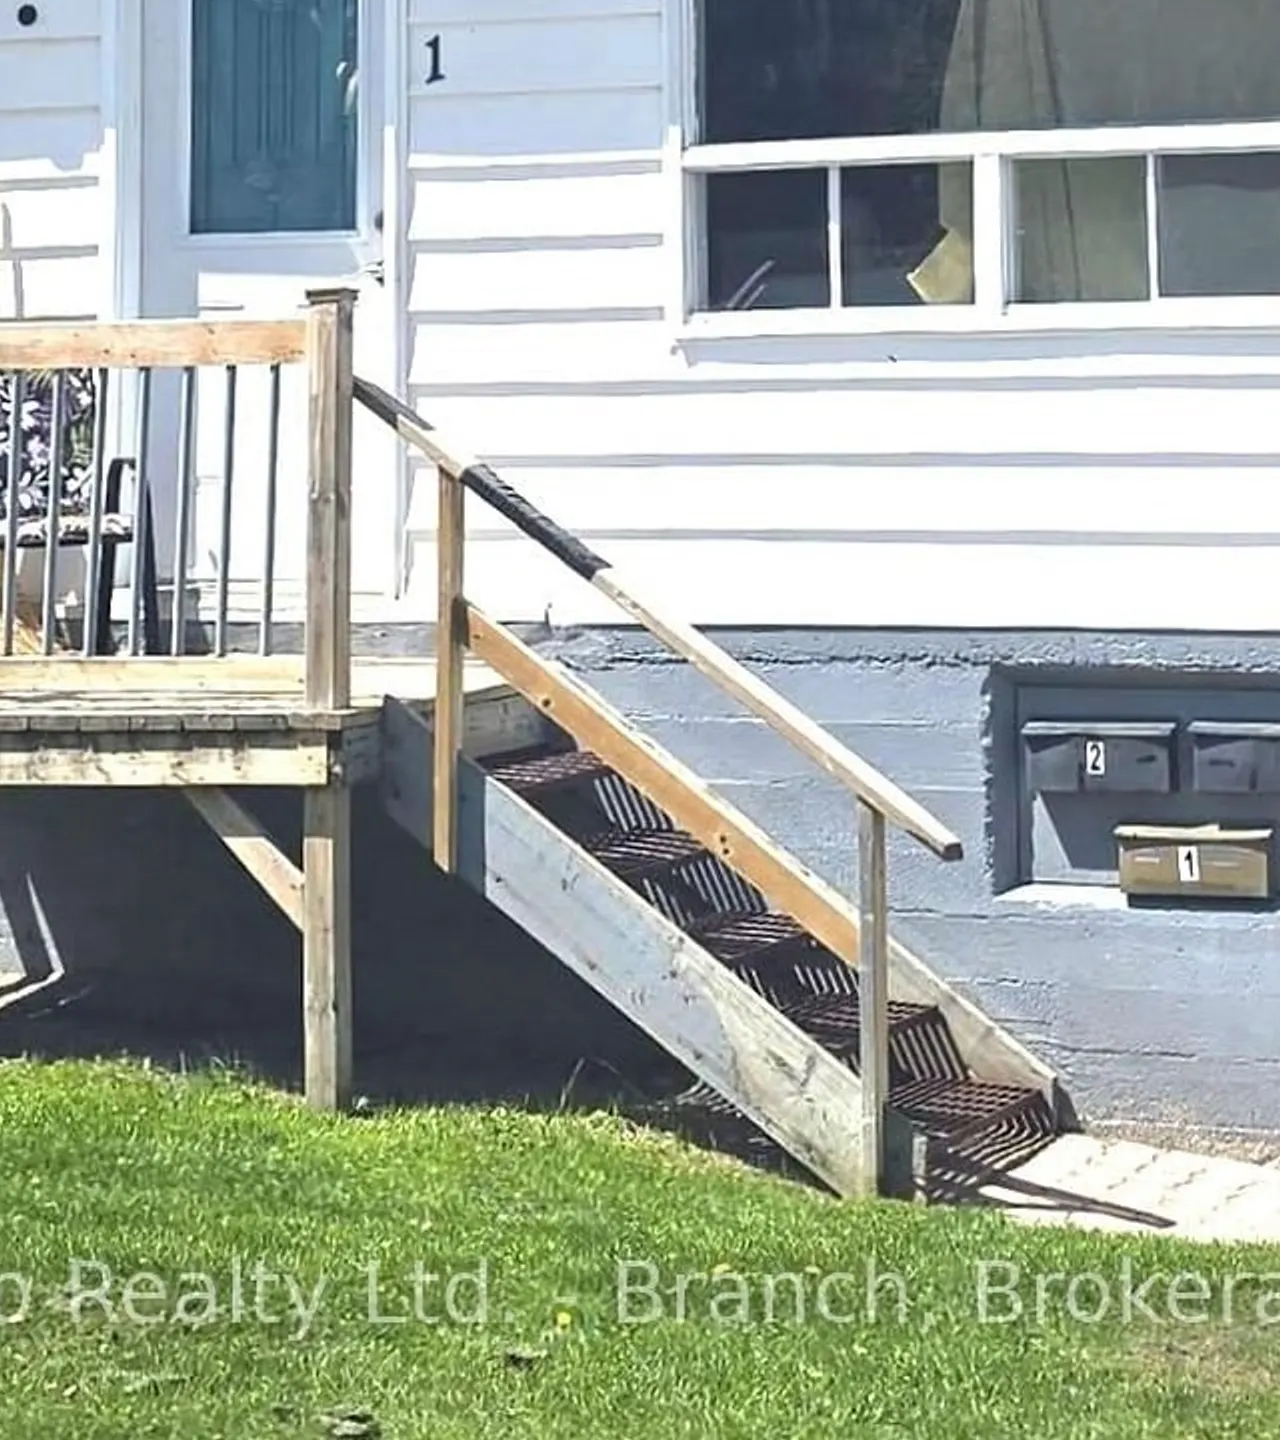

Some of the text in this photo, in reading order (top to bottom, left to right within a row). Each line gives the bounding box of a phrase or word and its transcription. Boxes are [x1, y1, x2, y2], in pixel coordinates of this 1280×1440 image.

[424, 34, 446, 84] 1
[1089, 743, 1102, 771] 2
[1183, 850, 1196, 879] 1
